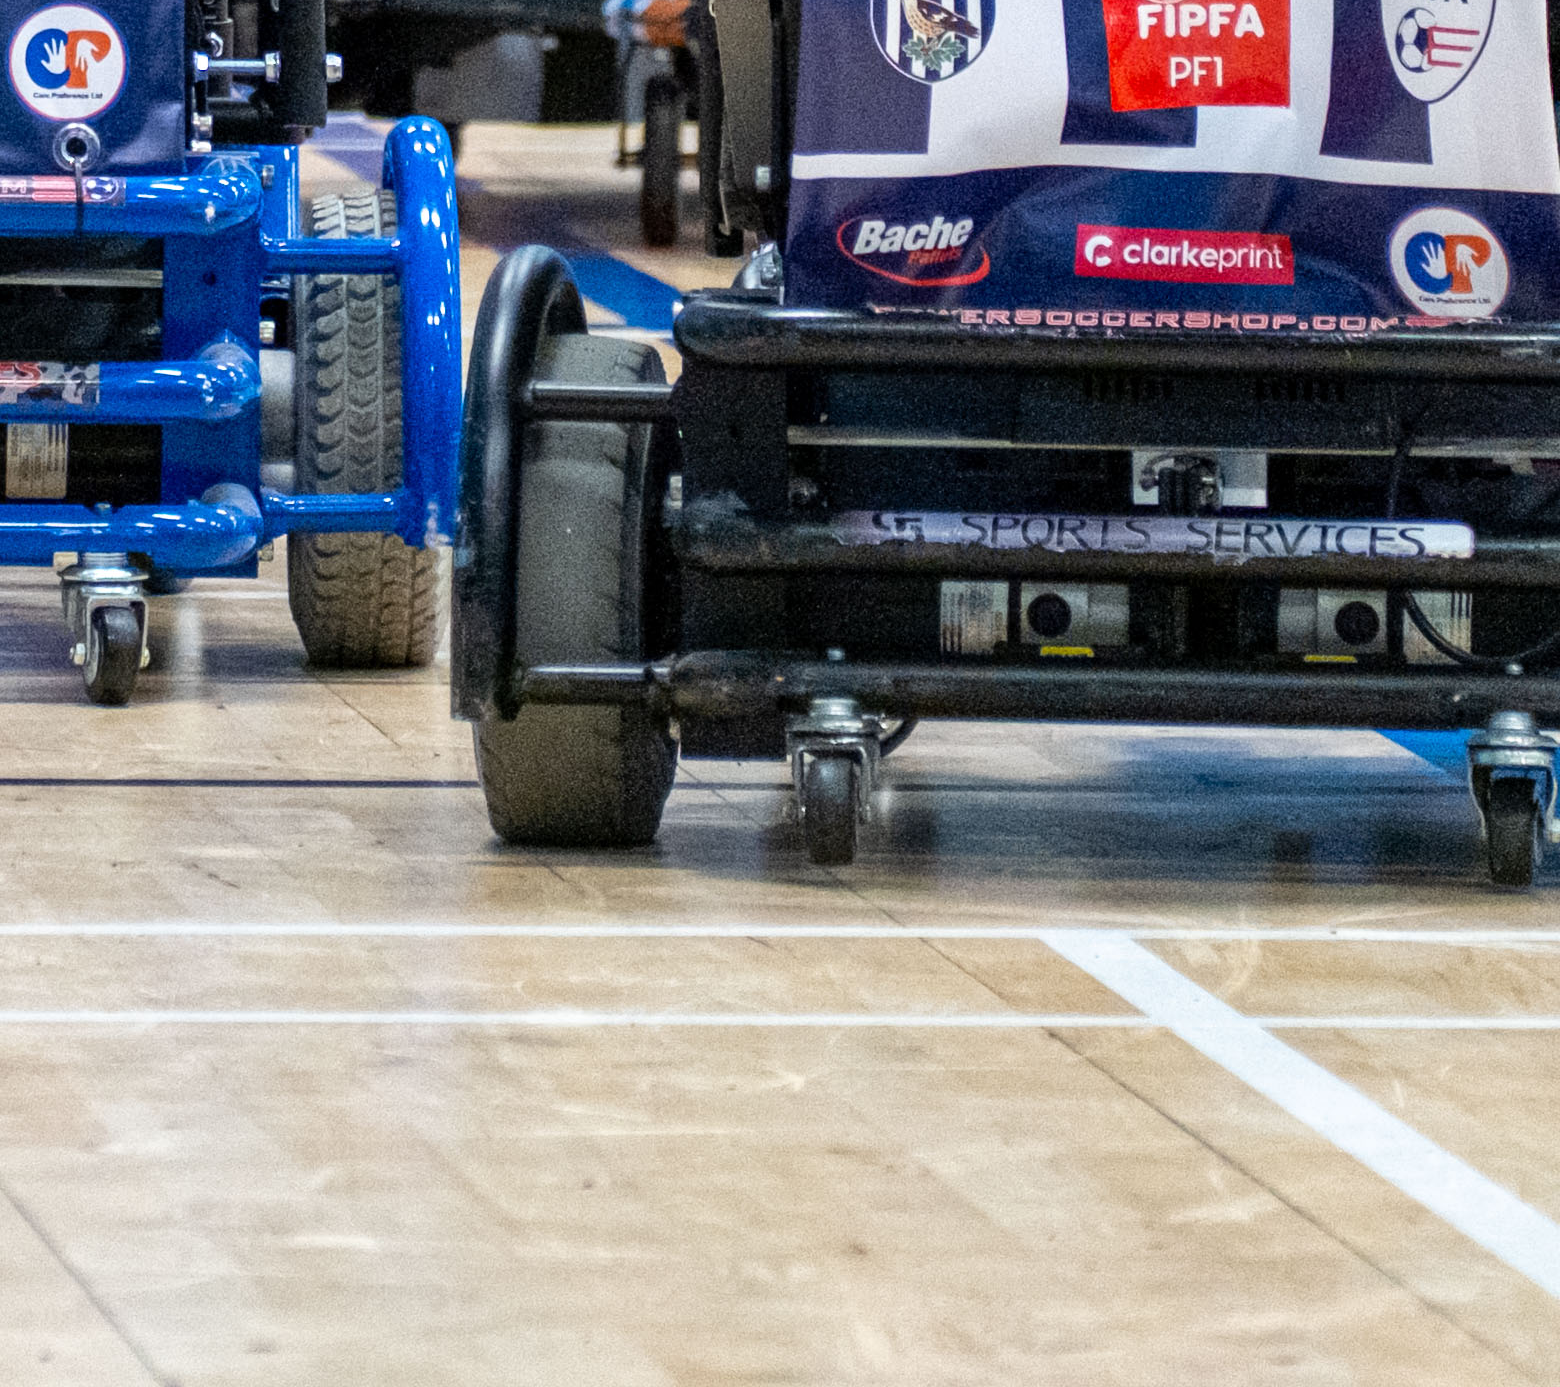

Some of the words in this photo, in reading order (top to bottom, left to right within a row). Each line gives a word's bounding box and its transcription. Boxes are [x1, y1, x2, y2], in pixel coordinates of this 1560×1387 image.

[1137, 3, 1266, 40] FIPFA
[1169, 55, 1224, 88] PF1
[853, 216, 974, 256] Bache
[1123, 238, 1284, 272] clarkeprint
[961, 515, 1151, 551] SPORTS
[1185, 520, 1426, 558] SERVICES
